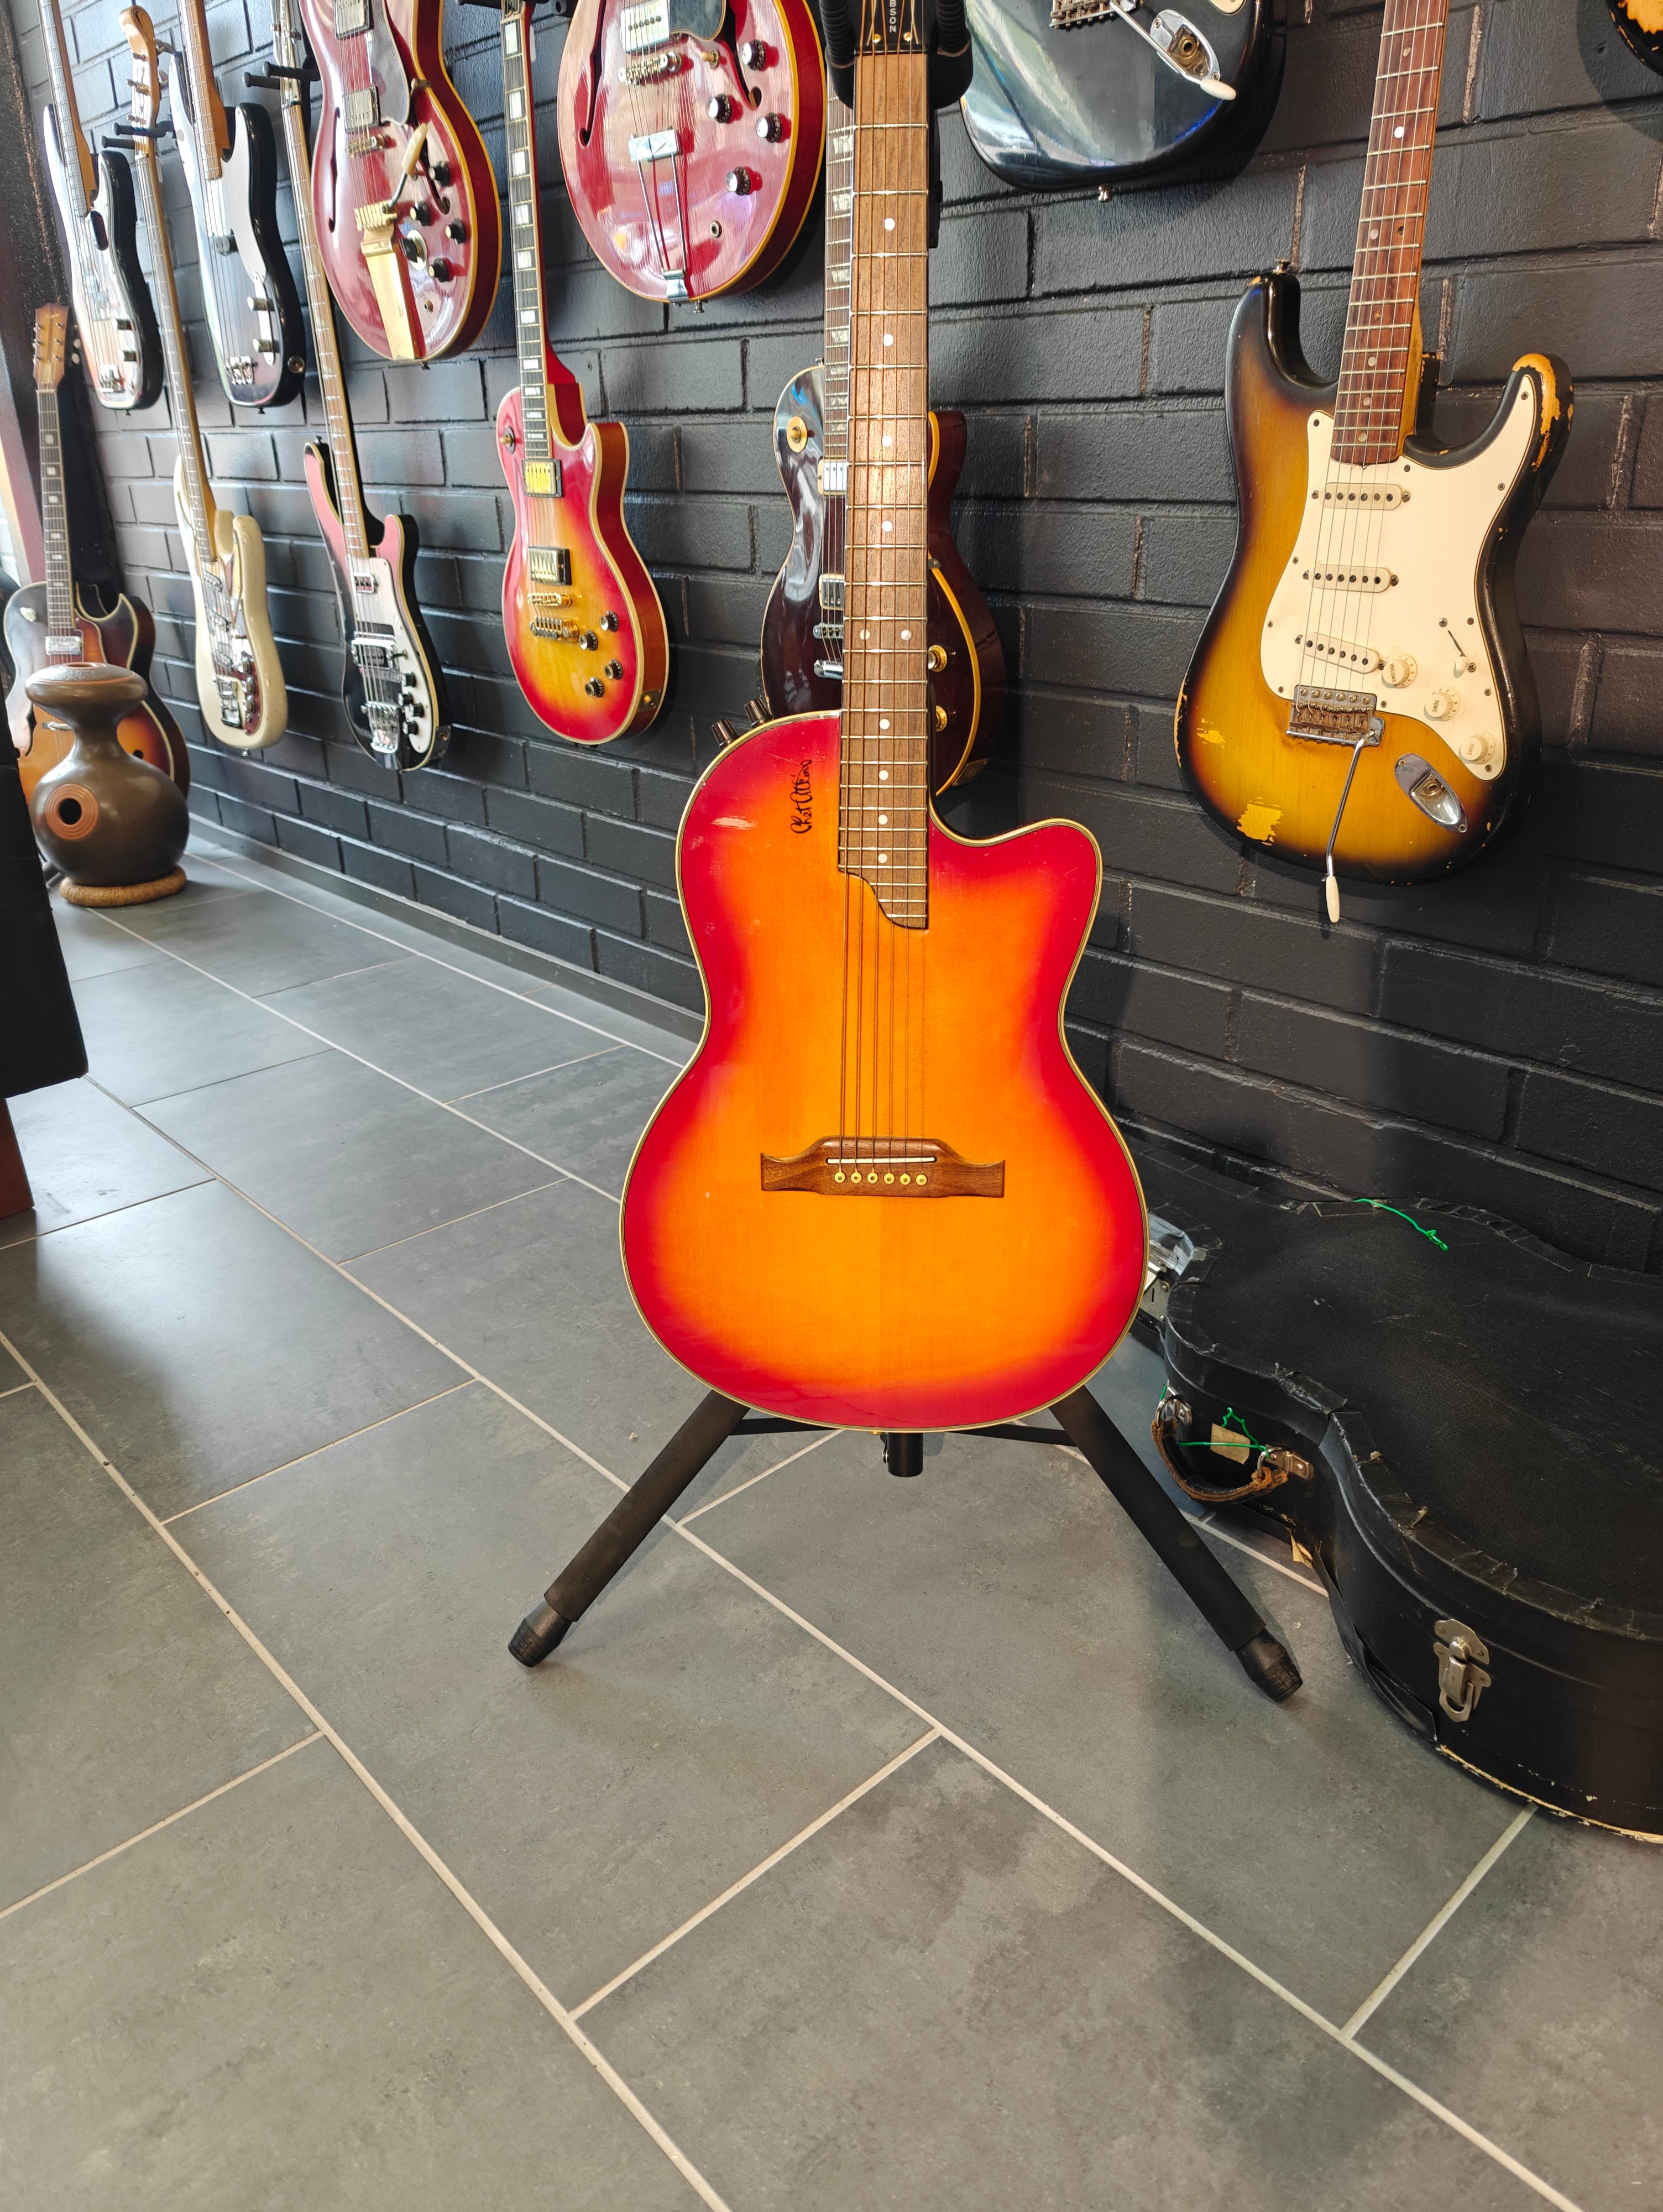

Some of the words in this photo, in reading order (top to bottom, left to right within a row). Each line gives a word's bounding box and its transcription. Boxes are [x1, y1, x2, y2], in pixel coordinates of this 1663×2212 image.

[1432, 699, 1440, 713] TONE
[1467, 743, 1476, 756] TONE
[789, 759, 813, 804] Atkins
[790, 800, 813, 834] Chet
